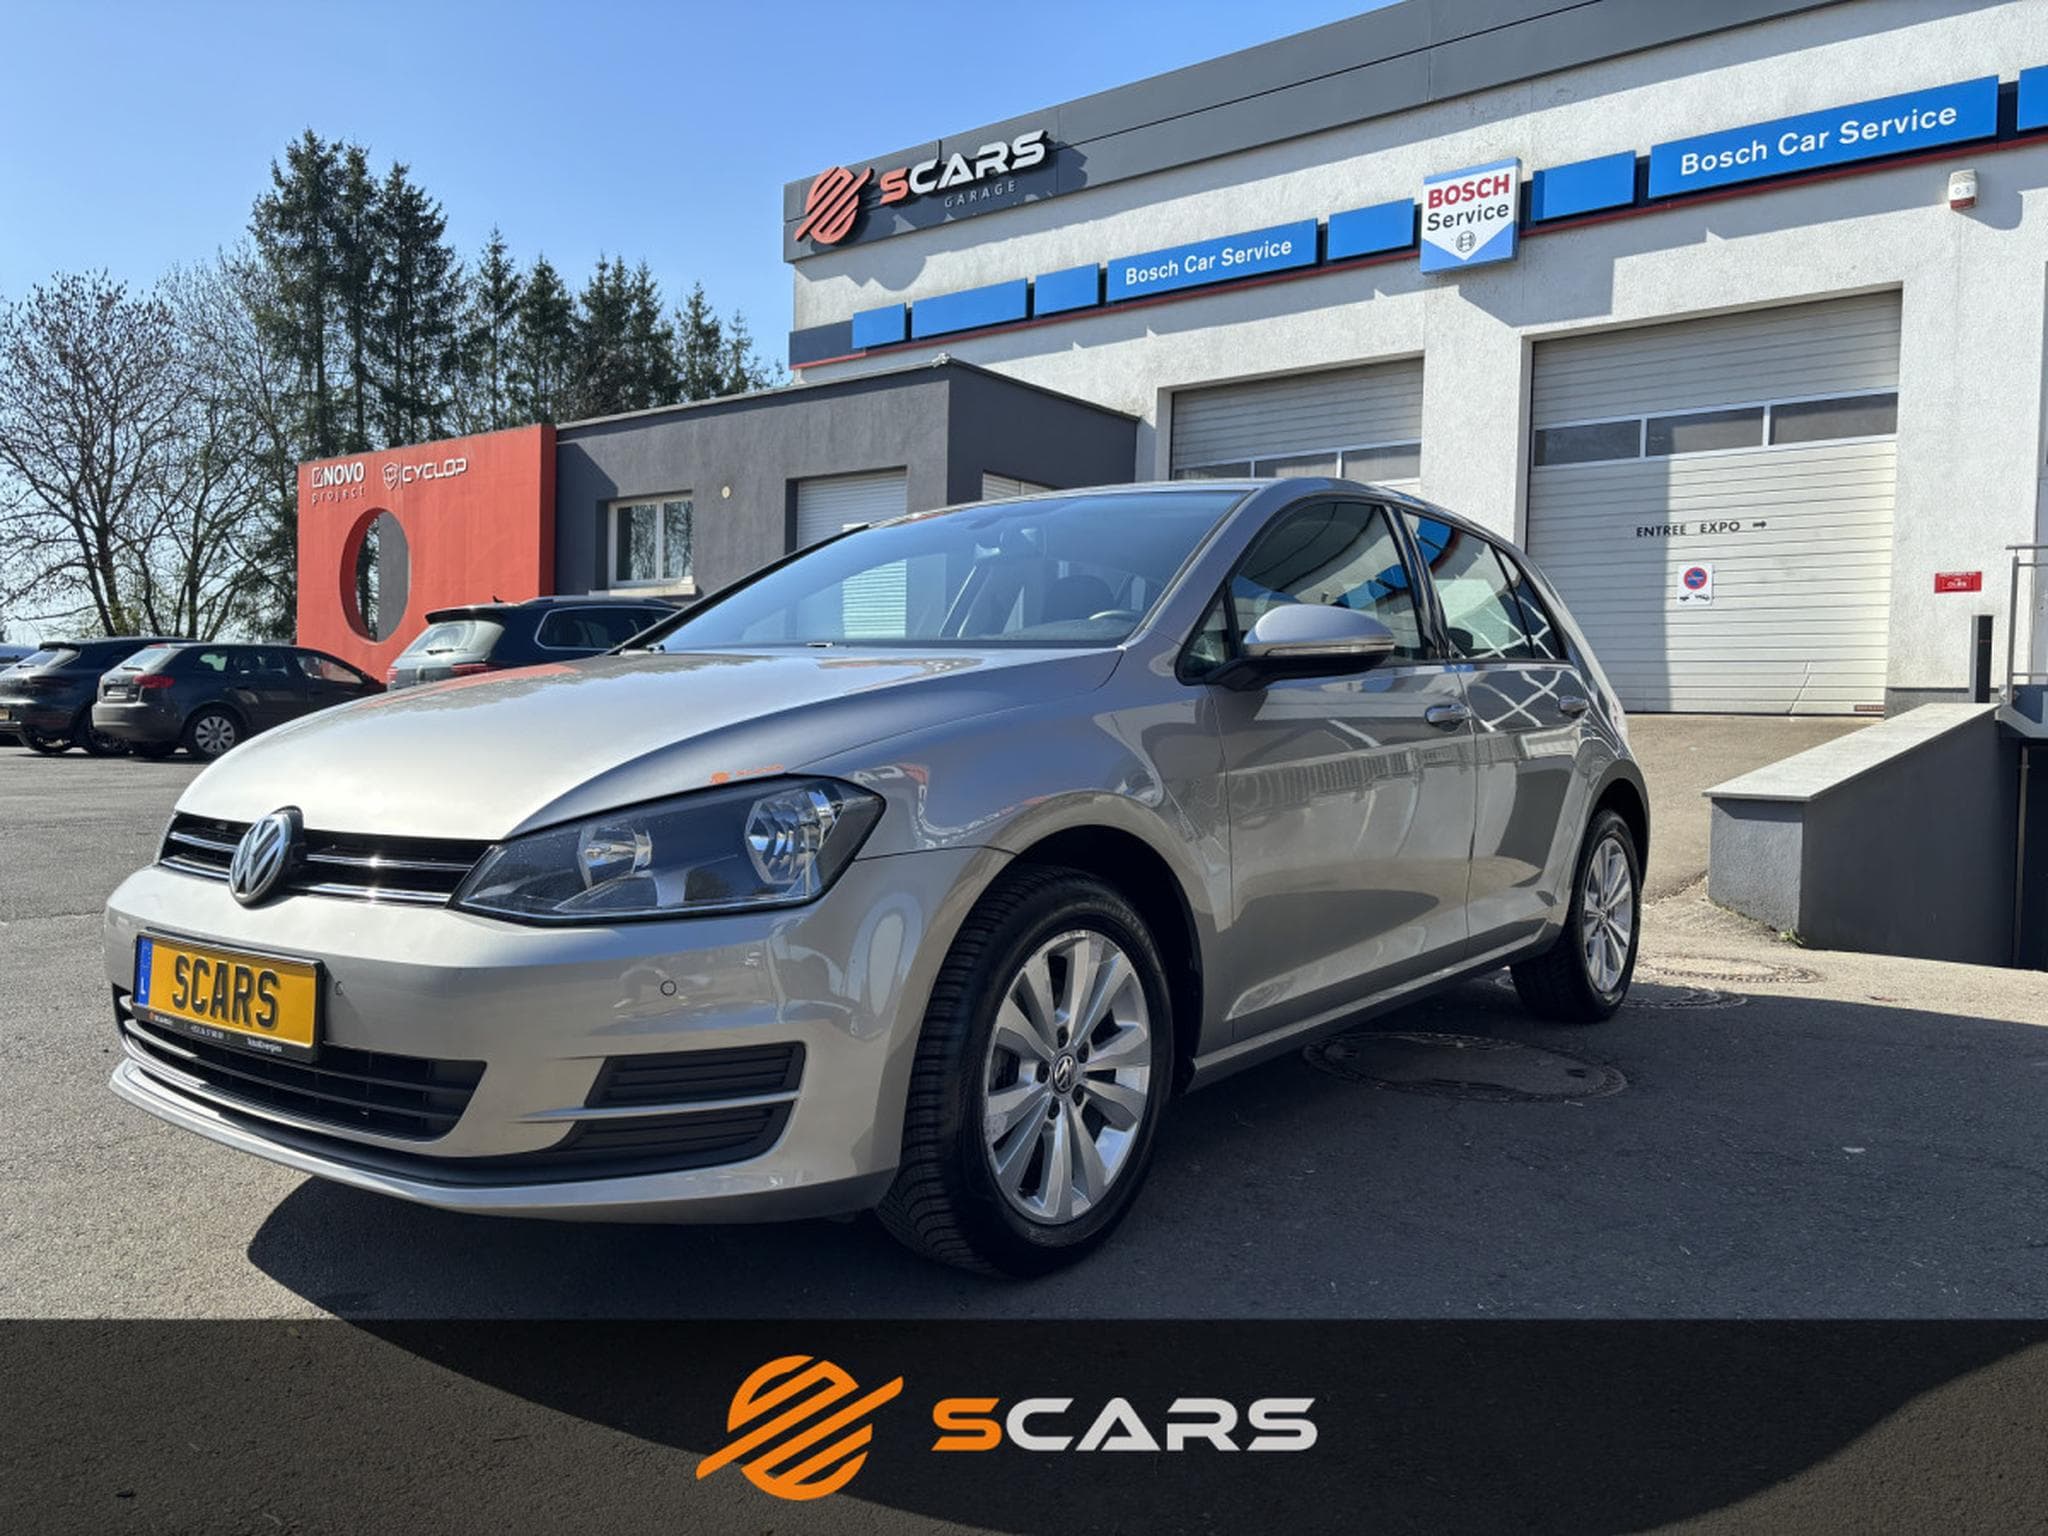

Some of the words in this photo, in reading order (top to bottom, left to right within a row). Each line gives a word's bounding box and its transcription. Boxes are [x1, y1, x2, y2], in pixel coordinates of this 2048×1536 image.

[1680, 139, 1768, 177] Bosch
[1777, 129, 1830, 156] Car
[1838, 107, 1957, 145] Service
[879, 129, 1046, 206] SCARS
[944, 180, 1016, 207] GARAGE
[1428, 173, 1510, 209] BOSCH
[1426, 203, 1510, 232] Service
[1125, 261, 1178, 285] Bosch
[1184, 254, 1218, 275] Car
[1221, 239, 1293, 266] Service
[402, 457, 467, 483] CYCLOP
[312, 484, 365, 505] project
[1700, 521, 1740, 534] EXPO
[172, 953, 279, 1030] SCARS
